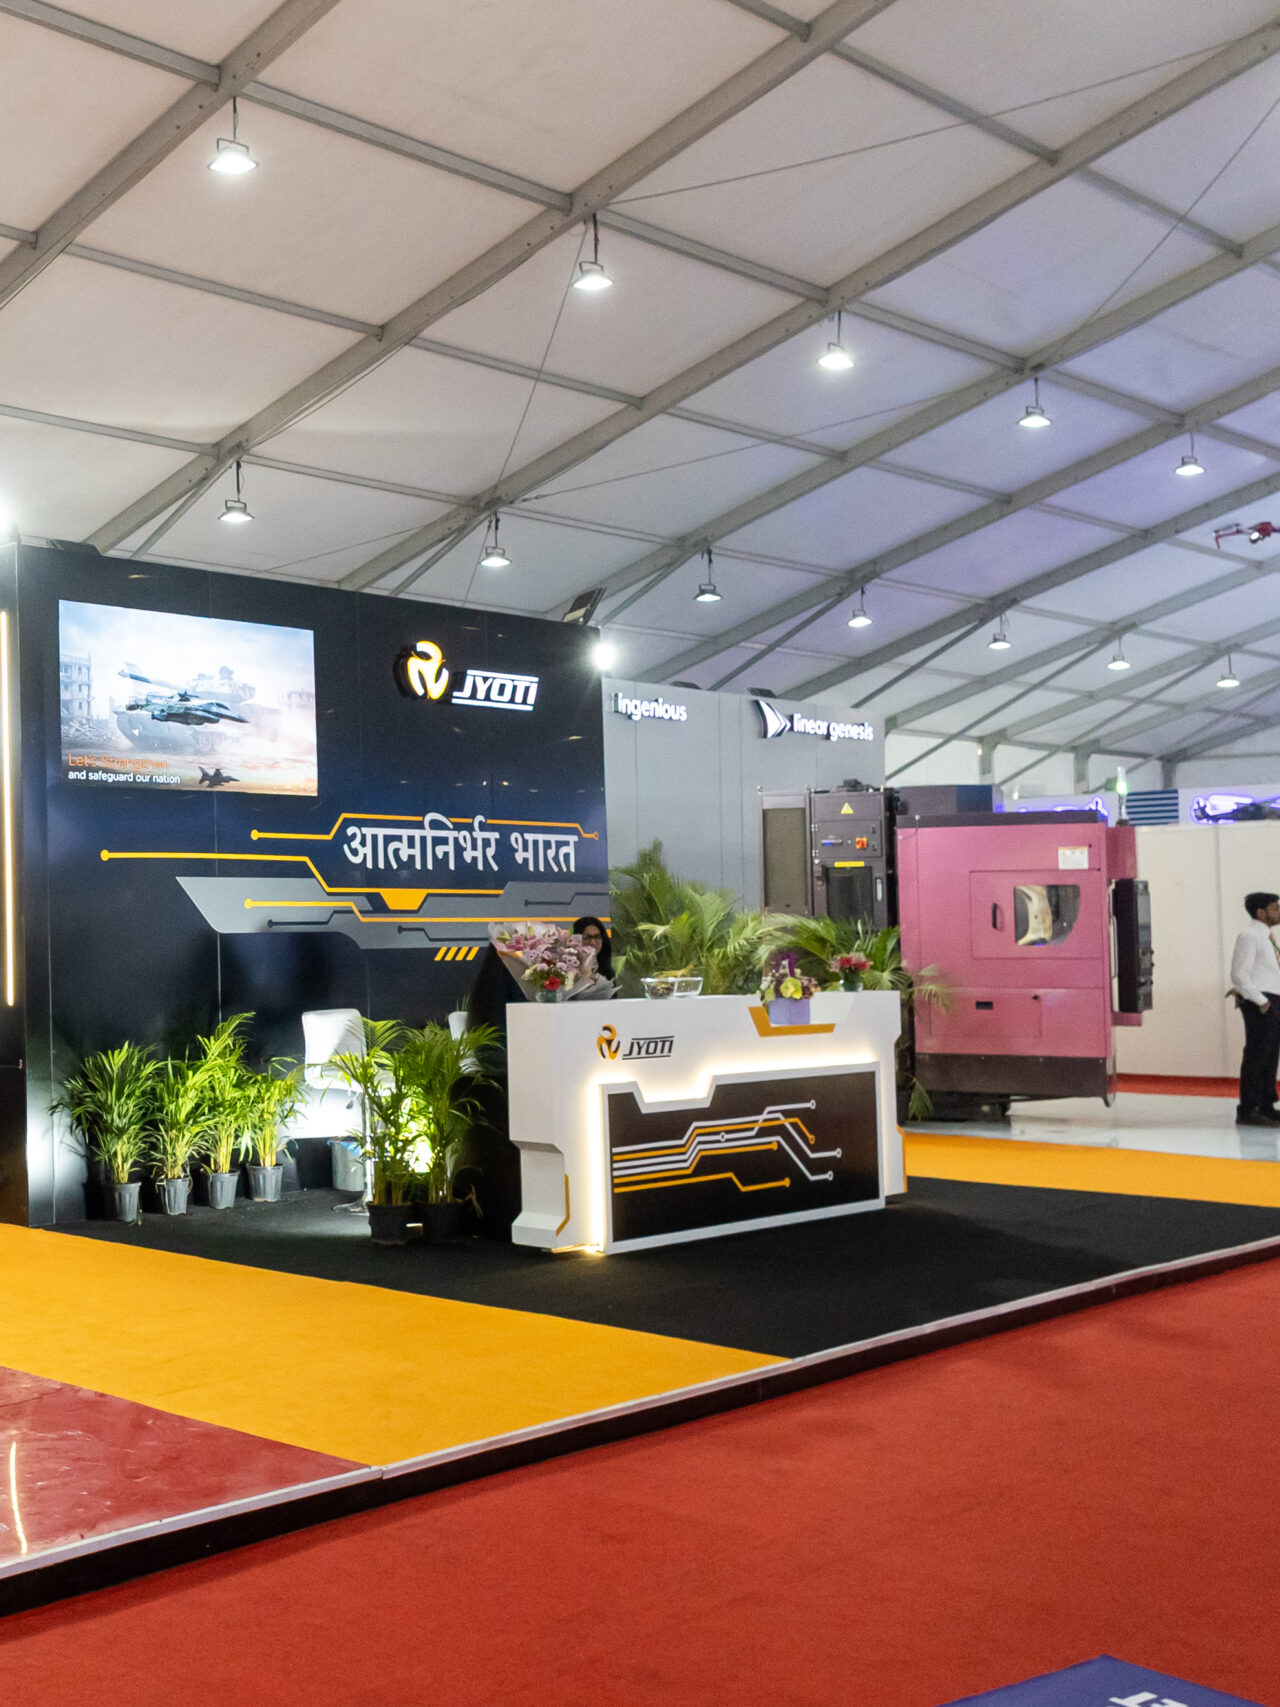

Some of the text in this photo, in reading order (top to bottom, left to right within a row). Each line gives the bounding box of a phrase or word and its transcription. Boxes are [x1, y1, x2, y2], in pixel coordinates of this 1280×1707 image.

[452, 673, 539, 705] JYOTI
[618, 692, 687, 721] ingenious
[793, 711, 873, 741] linear genesis
[68, 770, 180, 784] and safeguard our nation
[343, 812, 579, 872] आत्मनिर्भर भारत
[623, 1040, 673, 1057] JYOTI
